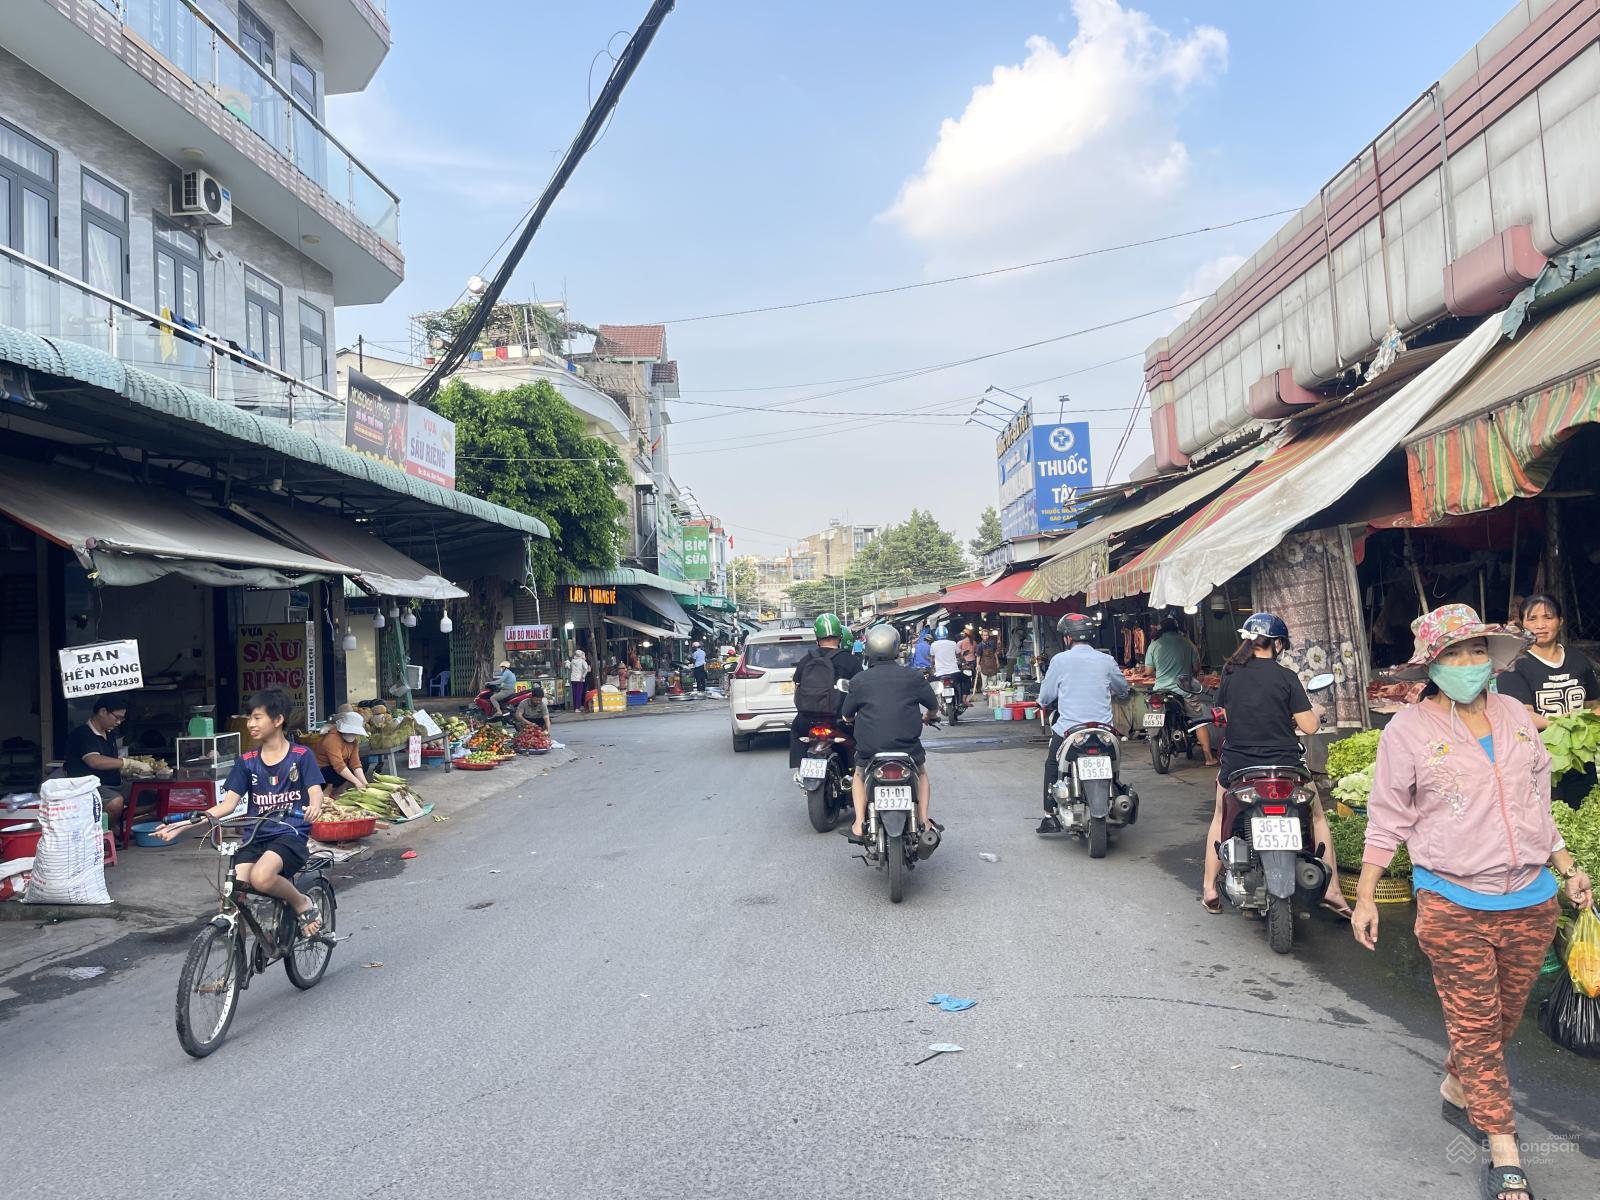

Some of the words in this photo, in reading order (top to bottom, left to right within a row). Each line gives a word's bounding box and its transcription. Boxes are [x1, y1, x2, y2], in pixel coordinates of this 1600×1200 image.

[1038, 453, 1088, 476] THUỐC
[1052, 484, 1077, 504] TÂY
[525, 629, 541, 640] MANG
[77, 649, 119, 665] BÁN
[64, 666, 95, 681] HẾN
[99, 663, 140, 677] NÓNG
[84, 677, 140, 692] 0972042839
[252, 790, 302, 806] Emirates
[876, 798, 909, 809] 233.77
[1259, 820, 1293, 833] 36-E1
[1256, 834, 1299, 848] 255.70
